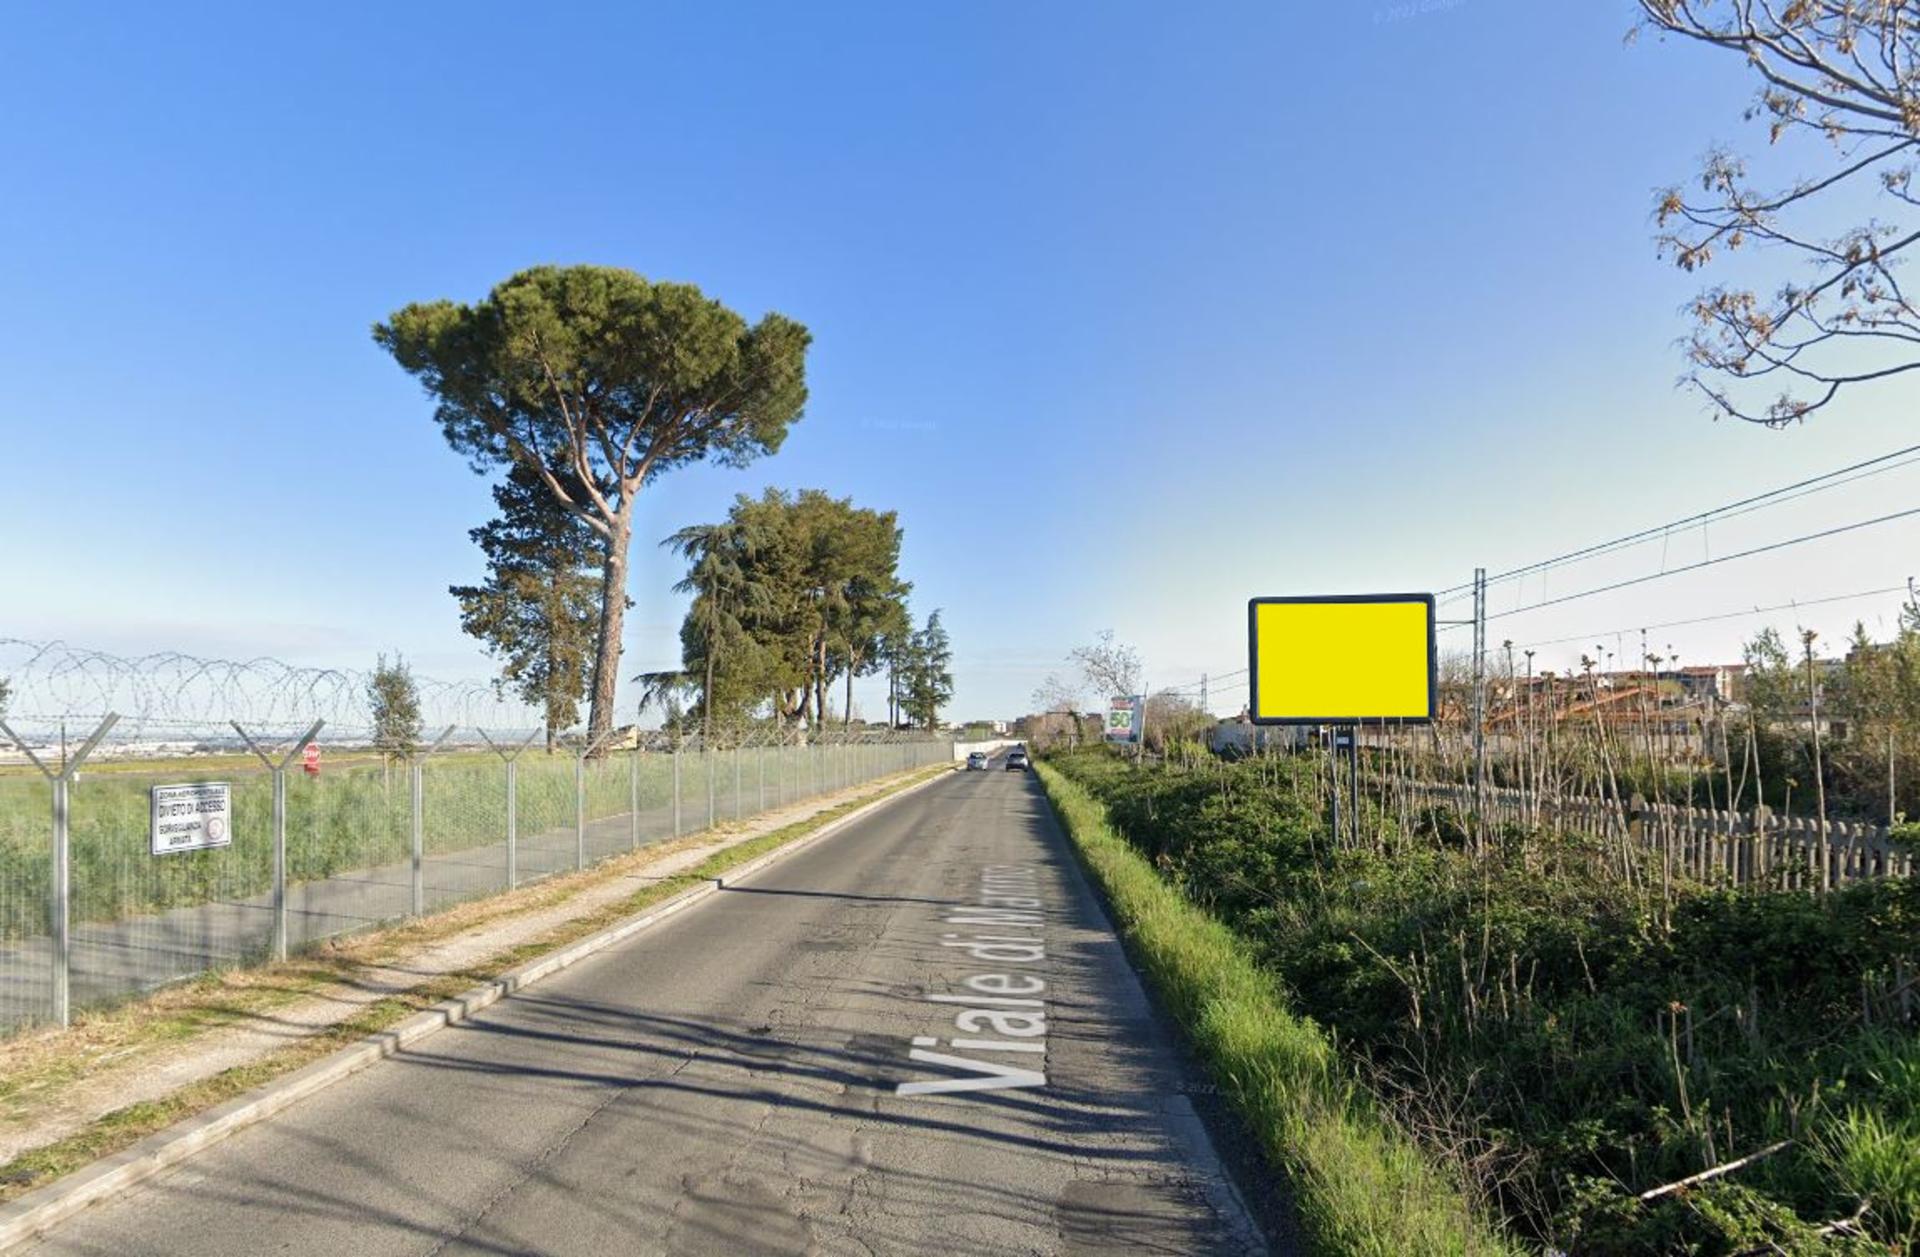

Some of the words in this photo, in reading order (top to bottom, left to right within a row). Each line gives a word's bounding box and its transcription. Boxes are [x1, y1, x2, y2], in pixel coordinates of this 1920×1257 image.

[159, 803, 186, 818] DIVIETO
[187, 802, 194, 815] DI
[195, 799, 225, 814] ACCESSO
